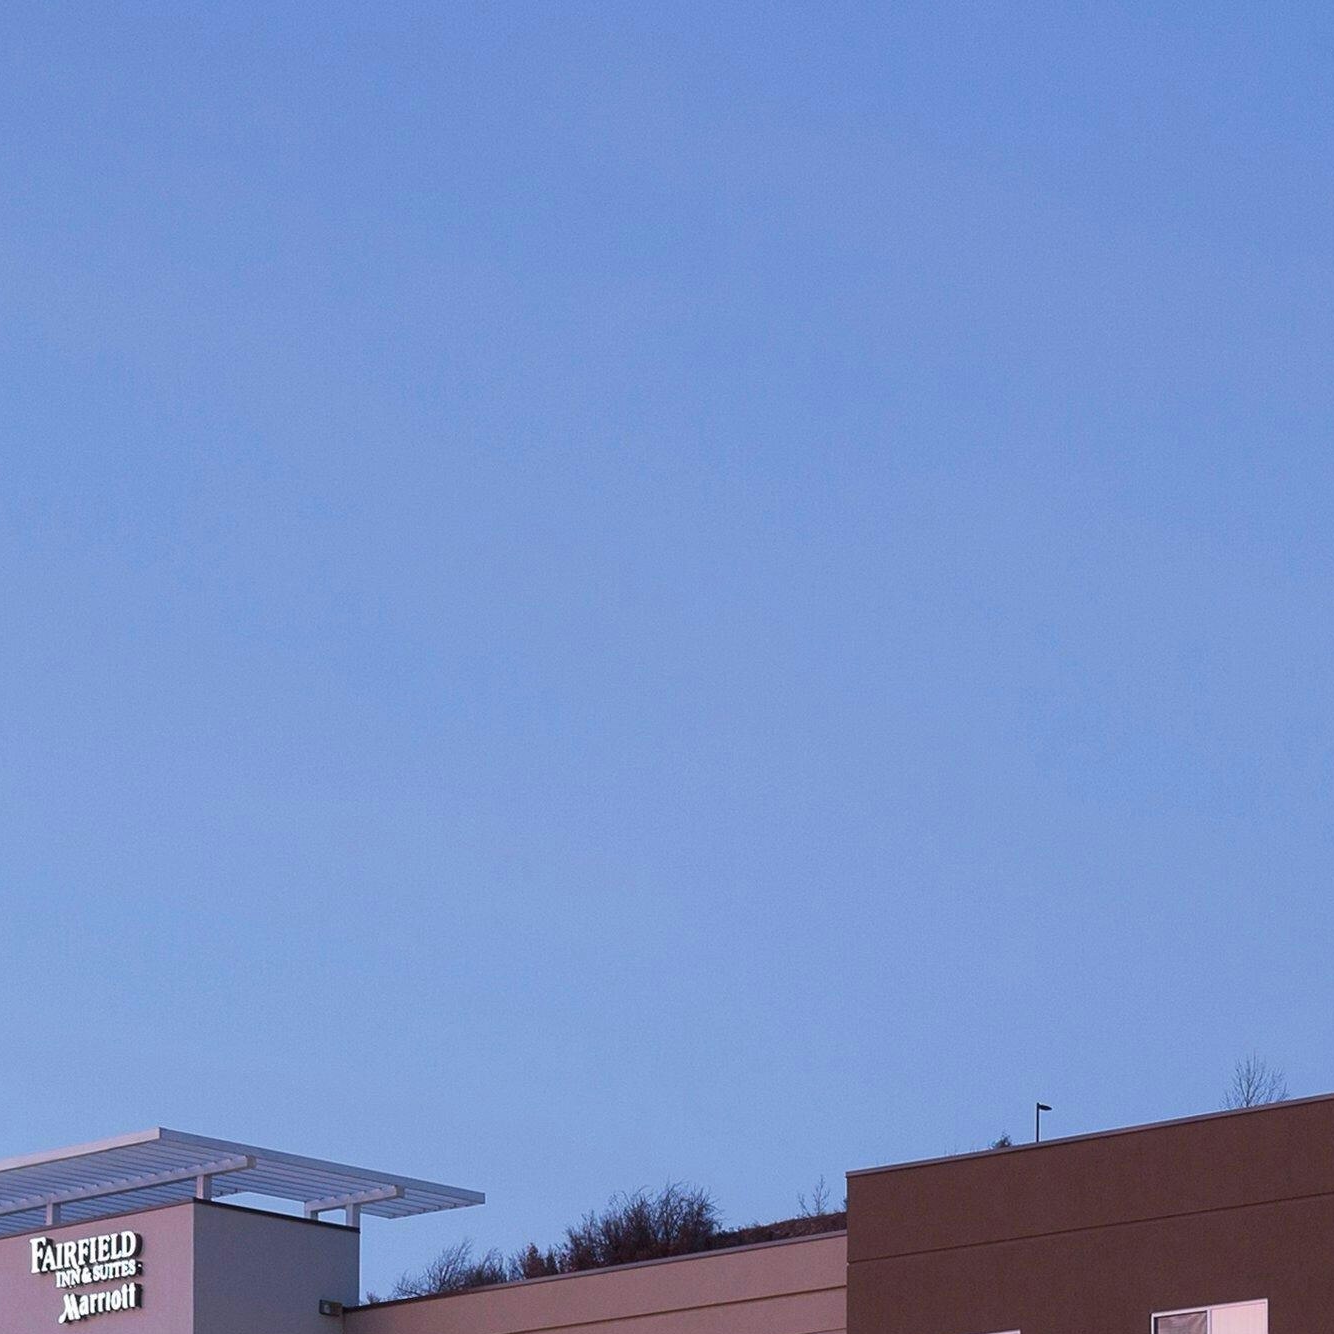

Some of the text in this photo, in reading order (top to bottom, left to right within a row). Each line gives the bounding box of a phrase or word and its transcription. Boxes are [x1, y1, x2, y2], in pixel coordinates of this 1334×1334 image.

[29, 1230, 138, 1274] FAIRFIELD
[55, 1259, 137, 1289] INN & SUITES
[58, 1282, 137, 1324] Marriott
